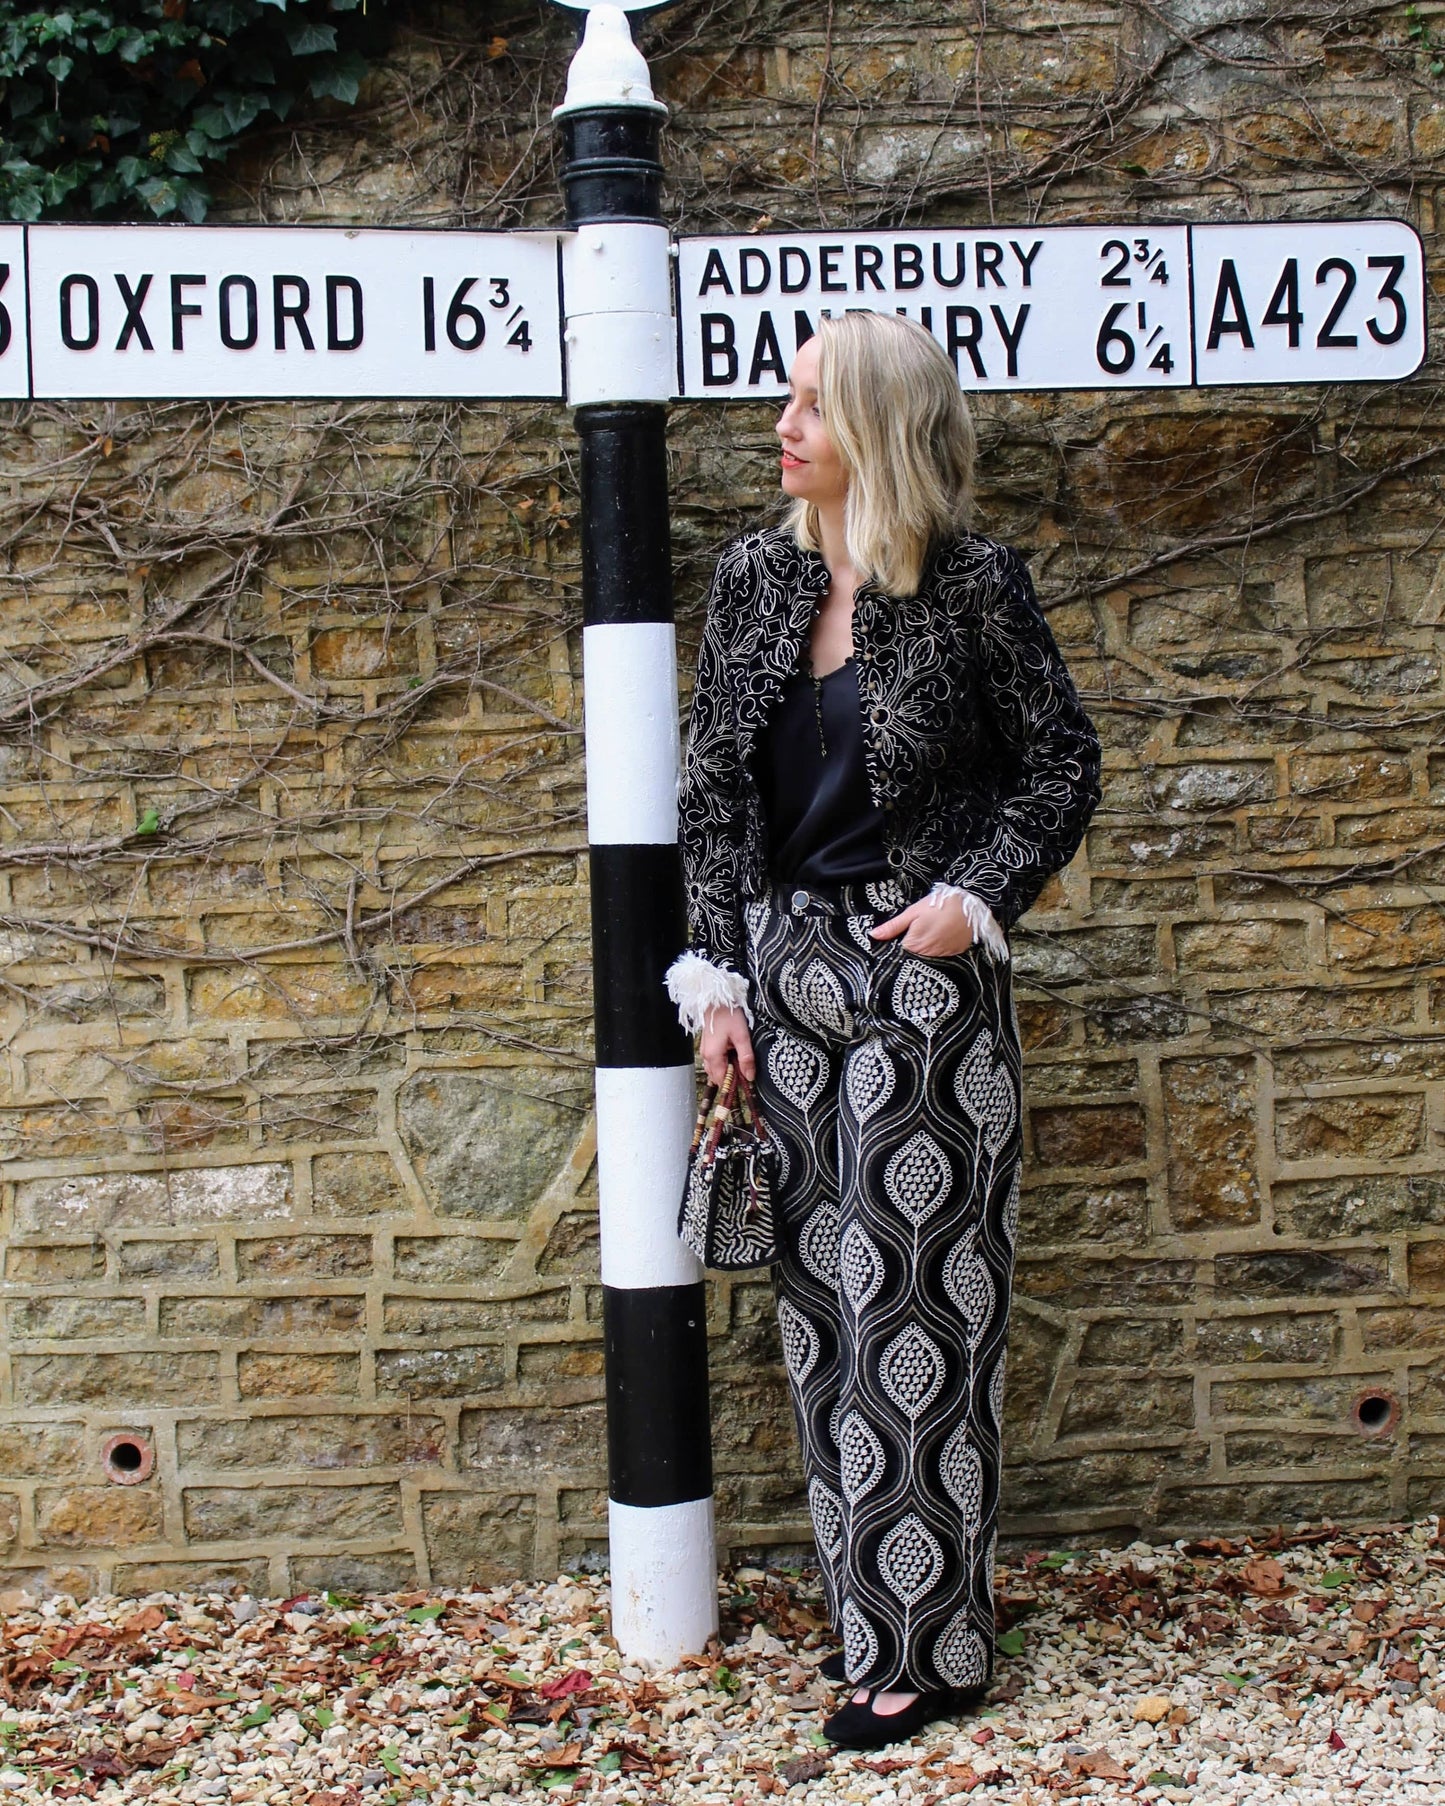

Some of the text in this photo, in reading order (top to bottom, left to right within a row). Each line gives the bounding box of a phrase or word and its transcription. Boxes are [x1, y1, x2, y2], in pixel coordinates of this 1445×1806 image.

[698, 241, 1044, 296] ADDERBURY
[1206, 255, 1407, 350] A423
[59, 273, 364, 351] OXFORD
[700, 302, 1031, 387] BARY
